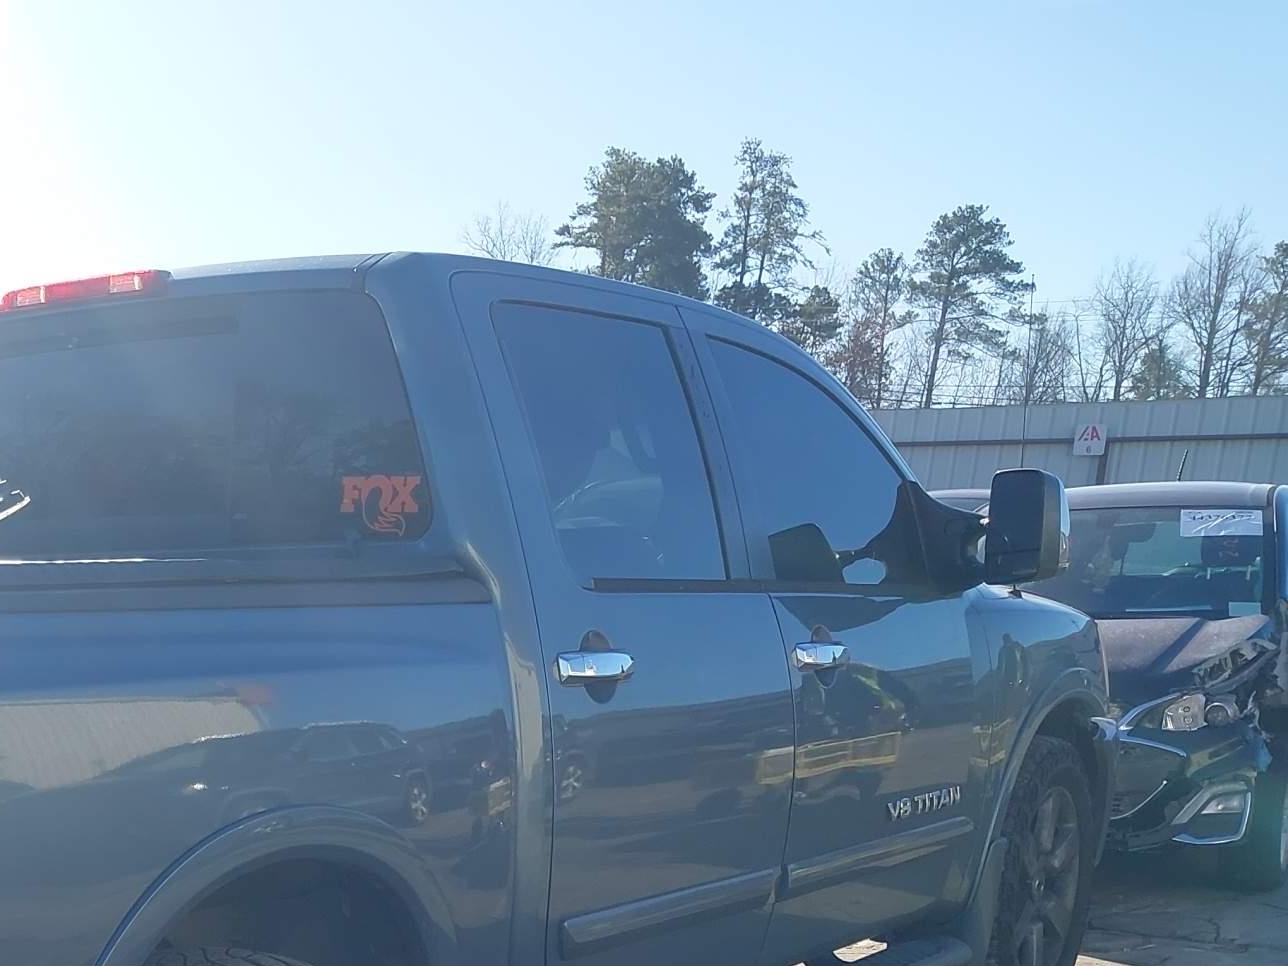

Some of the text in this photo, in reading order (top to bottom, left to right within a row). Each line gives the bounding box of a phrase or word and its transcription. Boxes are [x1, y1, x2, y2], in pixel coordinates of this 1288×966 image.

[339, 474, 421, 536] FOX
[887, 786, 961, 820] V8 TITAN
